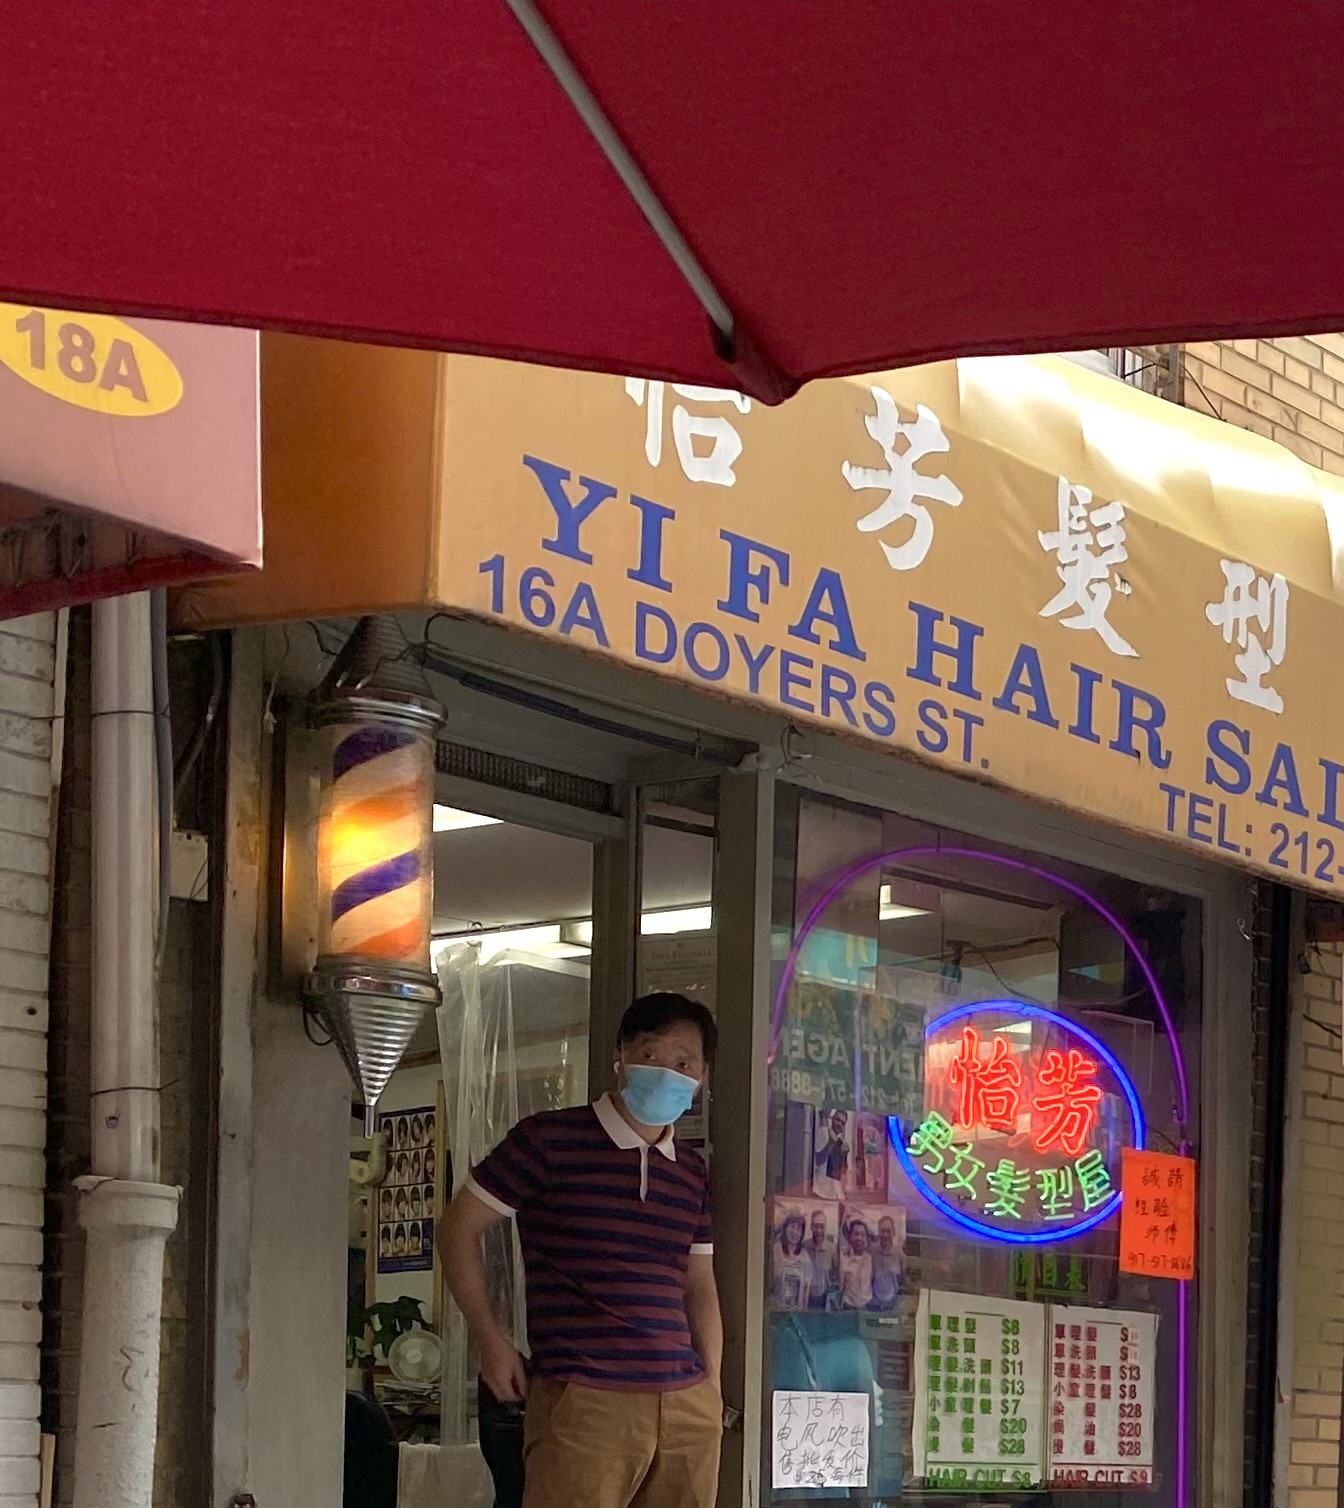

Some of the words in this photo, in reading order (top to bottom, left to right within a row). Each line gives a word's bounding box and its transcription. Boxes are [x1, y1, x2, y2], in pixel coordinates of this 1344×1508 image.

[16, 309, 148, 403] 18A
[522, 454, 675, 593] YI
[717, 529, 867, 662] FA
[906, 601, 1173, 770] HAIR
[479, 554, 611, 648] 16A
[635, 600, 896, 737] DOYERS
[917, 698, 990, 769] ST.
[1160, 783, 1253, 857] TEL:
[950, 1025, 1104, 1156] 怡芳
[905, 1110, 1117, 1220] 男女髮型屋
[1001, 1317, 1020, 1336] $8
[1001, 1338, 1020, 1356] $8
[1001, 1358, 1024, 1376] $11
[1119, 1364, 1141, 1381] $13
[1000, 1377, 1025, 1396] $13
[1119, 1383, 1137, 1399] $8
[776, 1393, 846, 1422] 本店有
[1000, 1399, 1020, 1415] $7
[1118, 1403, 1142, 1419] $28
[1000, 1418, 1027, 1434] $20
[1118, 1421, 1142, 1438] $20
[776, 1422, 865, 1451] 电风吹出
[999, 1438, 1025, 1455] $28
[1118, 1440, 1142, 1457] $28
[928, 1468, 968, 1489] HAIR
[973, 1470, 1007, 1490] CUT
[1012, 1470, 1031, 1489] $8
[1053, 1468, 1089, 1485] HAIR
[1097, 1469, 1125, 1486] CUT
